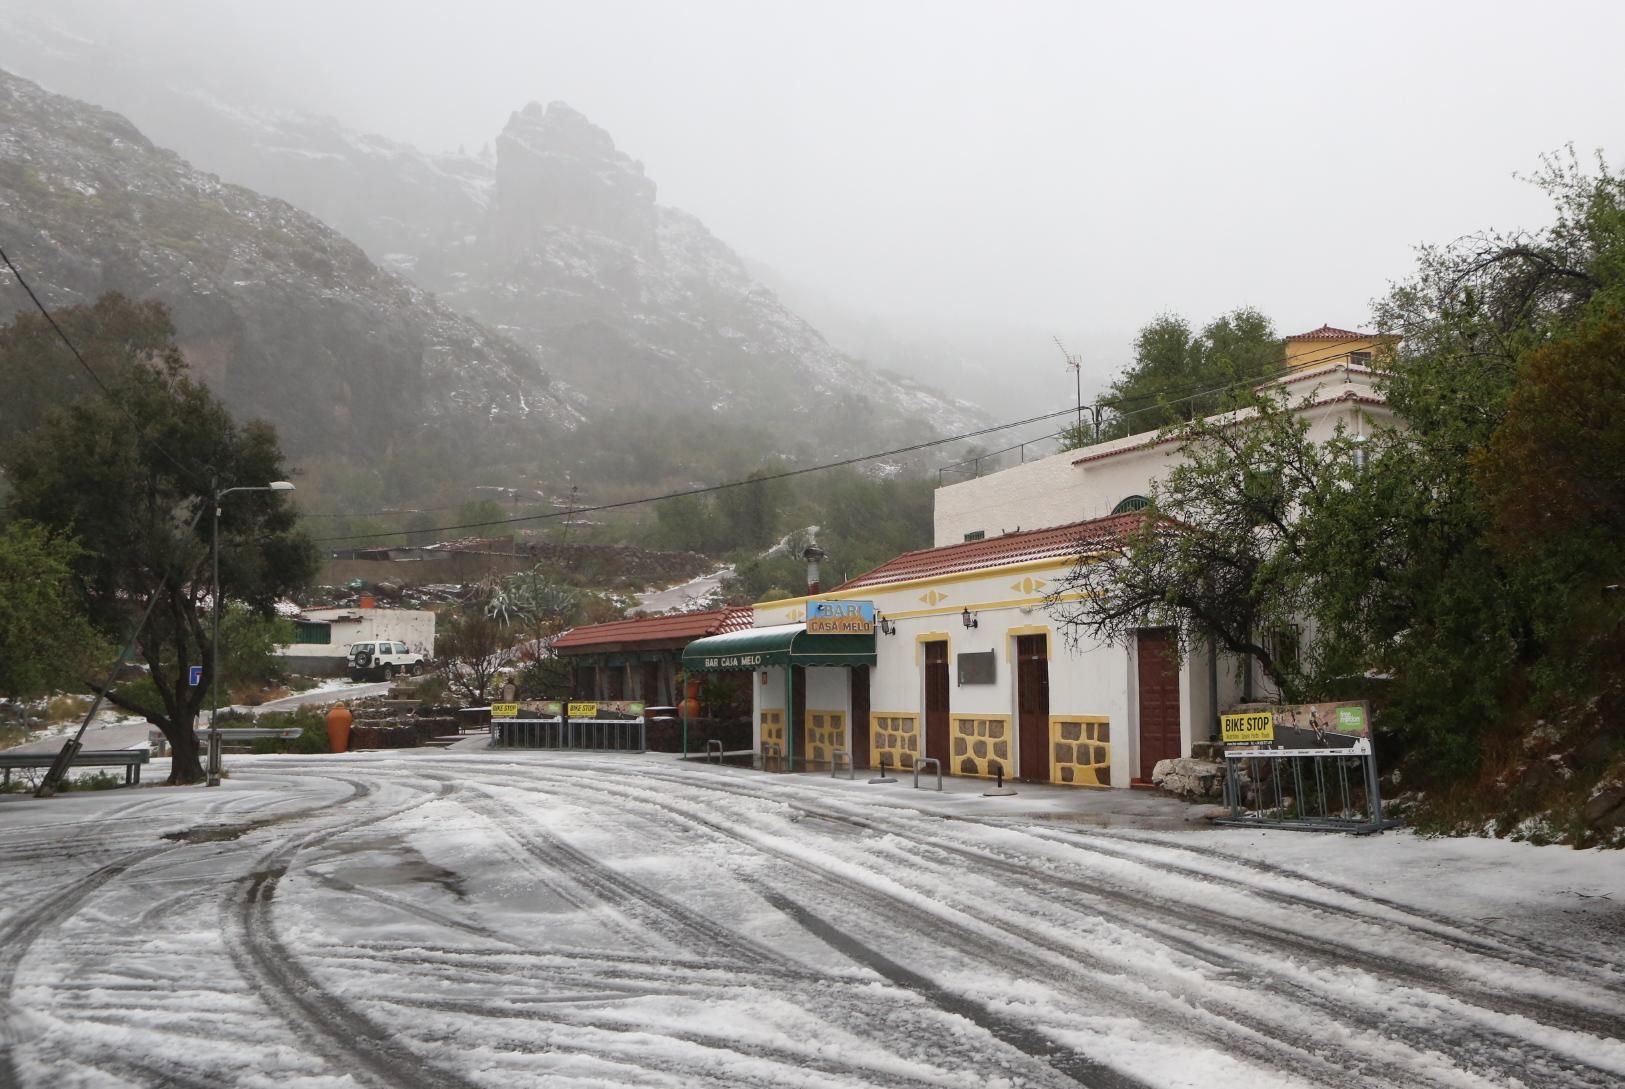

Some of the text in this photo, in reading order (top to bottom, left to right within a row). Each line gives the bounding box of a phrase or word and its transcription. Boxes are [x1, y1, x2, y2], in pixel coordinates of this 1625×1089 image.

[811, 622, 870, 632] CASA MELO
[705, 655, 761, 667] BAR CASA MELO
[1225, 716, 1270, 732] BIKE STOP
